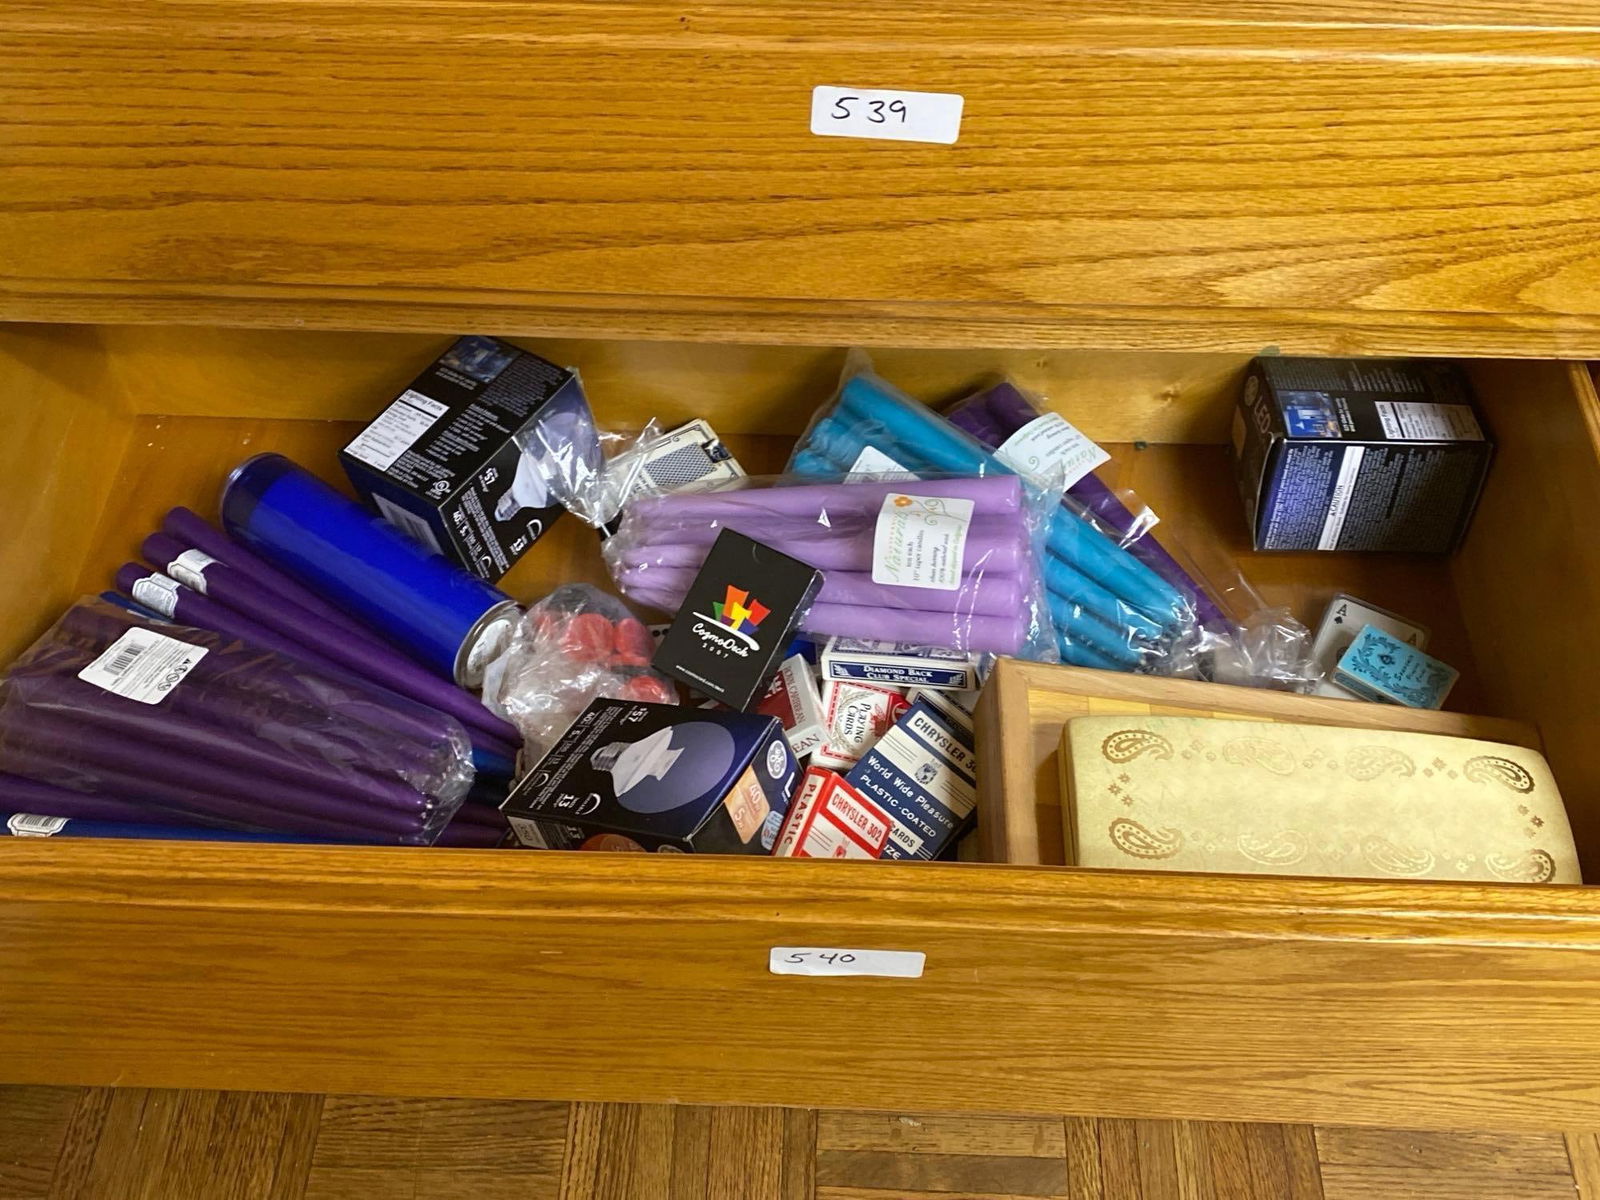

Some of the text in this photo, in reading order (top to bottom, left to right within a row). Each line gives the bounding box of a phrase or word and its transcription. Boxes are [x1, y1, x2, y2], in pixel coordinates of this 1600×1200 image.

[427, 401, 442, 411] Facts
[1254, 395, 1271, 434] LED
[1379, 404, 1396, 438] Lighting Facts
[1332, 485, 1344, 512] CAUTION
[1336, 604, 1347, 616] A
[863, 665, 933, 677] DIAMOND BACK
[866, 672, 929, 683] CLUB SPECIAL
[844, 705, 859, 735] CARDS
[854, 703, 871, 743] PLAYING
[914, 717, 966, 762] CHRYSLER
[868, 756, 954, 829] World Wide Pleasure
[784, 783, 817, 845] PLASTIC
[831, 793, 883, 843] CHRYSLER 302
